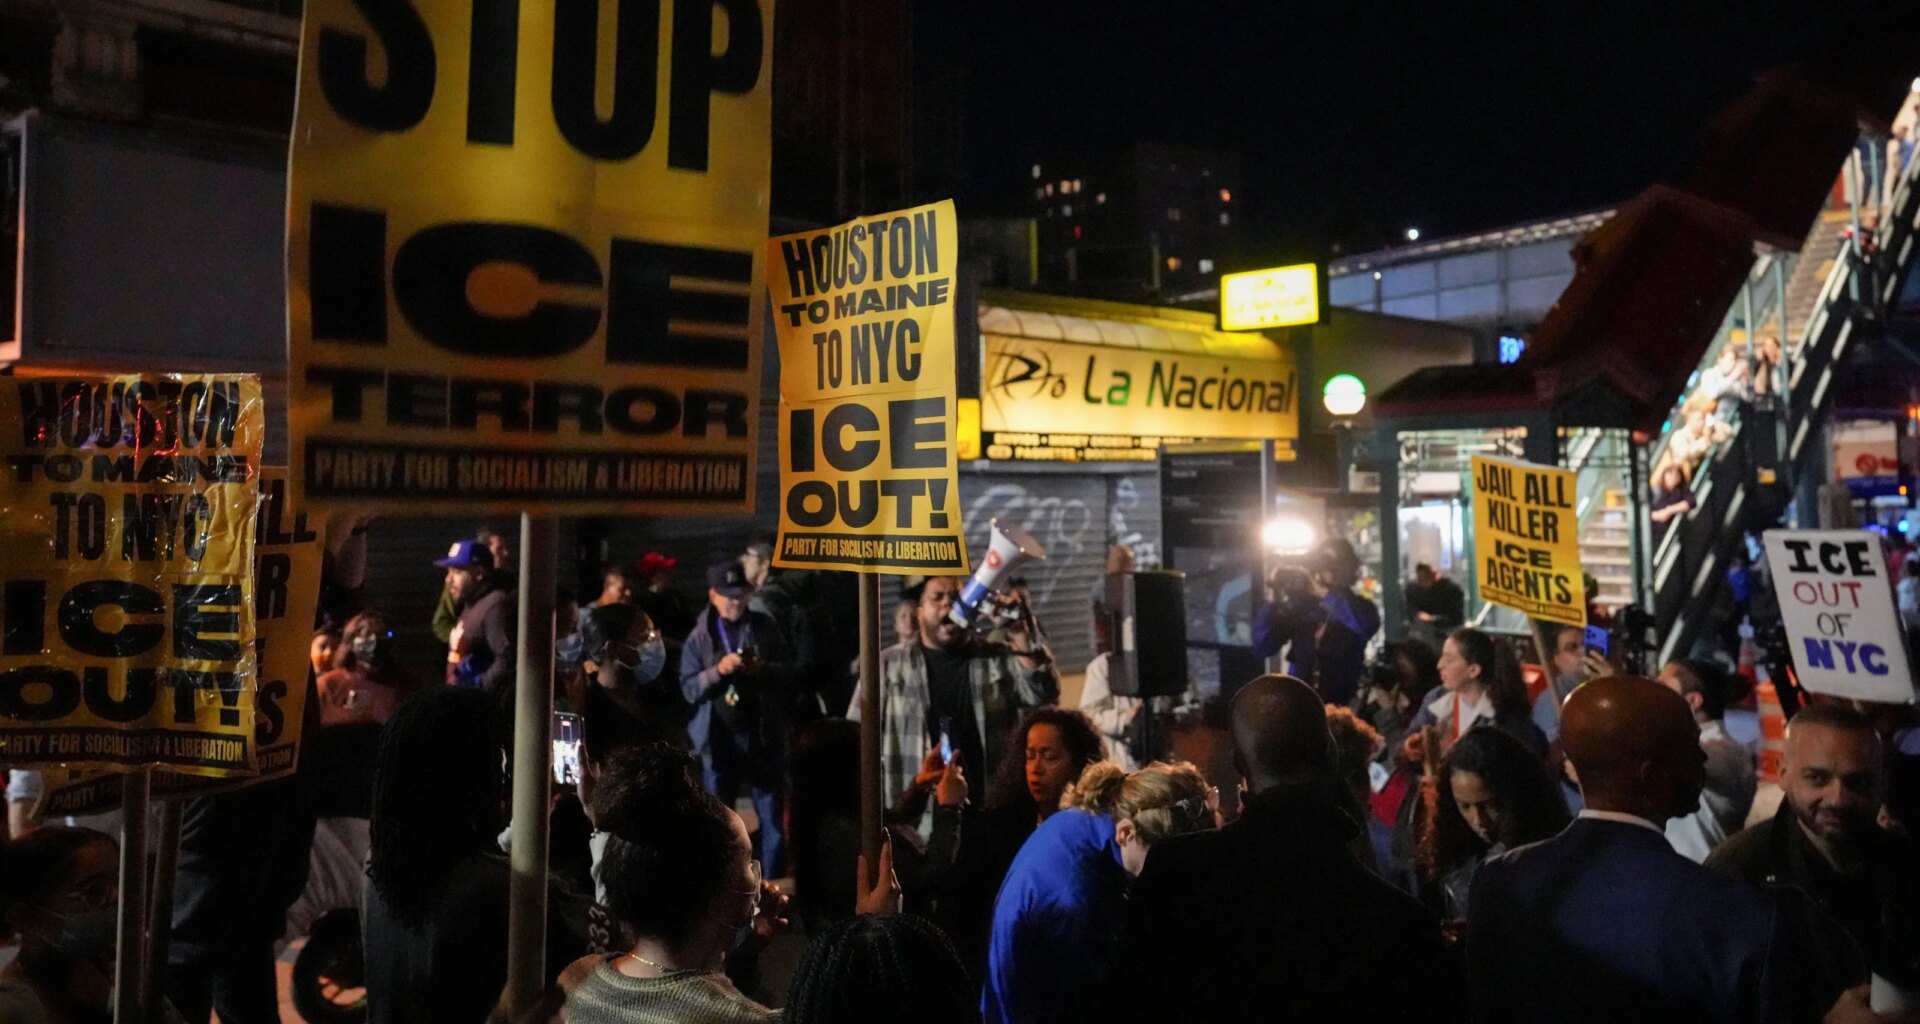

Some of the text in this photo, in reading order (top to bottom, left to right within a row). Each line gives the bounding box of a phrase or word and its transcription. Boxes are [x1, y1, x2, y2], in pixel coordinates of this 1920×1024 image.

[317, 0, 764, 174] STOP
[782, 210, 938, 298] HOUSTON
[309, 204, 754, 373] ICE
[782, 278, 950, 328] TO MAINE
[813, 318, 921, 390] TO NYC
[305, 364, 749, 438] TERROR
[1083, 354, 1296, 413] La Nacional
[18, 381, 240, 448] HOUSTON
[790, 396, 947, 473] ICE
[6, 454, 83, 483] TO
[314, 448, 741, 493] PARTY FOR SOCIALISM & LIBERATION
[1477, 463, 1571, 509] JAIL ALL
[50, 492, 210, 561] TO NYC
[786, 478, 949, 529] OUT!
[1487, 498, 1559, 544] KILLER
[785, 538, 817, 556] PARTY
[820, 539, 838, 556] FOR
[887, 543, 893, 559] &
[896, 541, 958, 561] LIBERATION
[1495, 540, 1552, 569] ICE
[1783, 540, 1876, 577] ICE
[1487, 557, 1572, 604] AGENTS
[1793, 582, 1862, 608] OUT
[3, 579, 242, 657] ICE
[1817, 612, 1851, 638] OF
[1803, 636, 1889, 676] NYC
[0, 664, 244, 726] OUT!
[50, 733, 80, 754] FOR
[174, 735, 244, 762] LIBERATION
